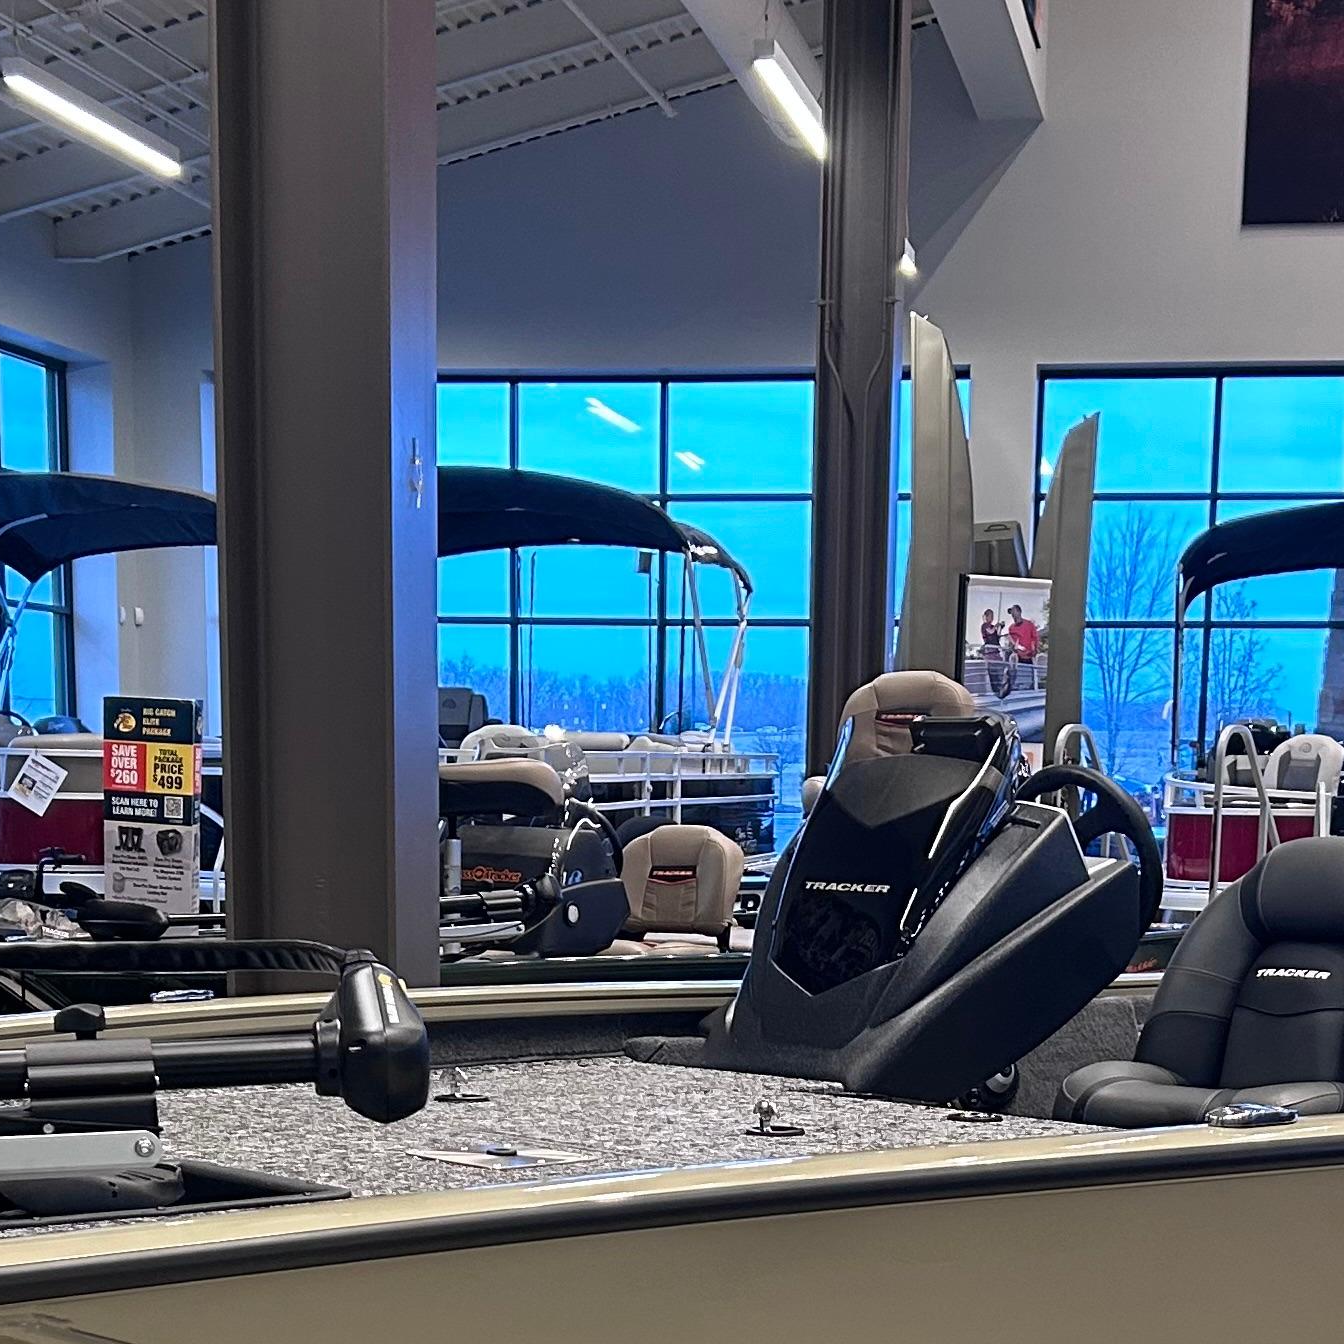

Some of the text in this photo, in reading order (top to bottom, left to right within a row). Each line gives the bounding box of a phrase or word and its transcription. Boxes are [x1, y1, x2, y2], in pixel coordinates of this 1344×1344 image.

[111, 744, 138, 757] SAVE
[158, 748, 178, 757] TOTAL
[111, 757, 138, 770] OVER
[154, 755, 183, 764] PACKAGE
[153, 763, 184, 775] PRICE
[110, 769, 138, 785] $260
[152, 774, 183, 789] $499
[111, 796, 130, 806] SCAN
[149, 798, 159, 808] TO
[805, 881, 891, 893] TRACKER
[1256, 968, 1332, 980] TRACKER
